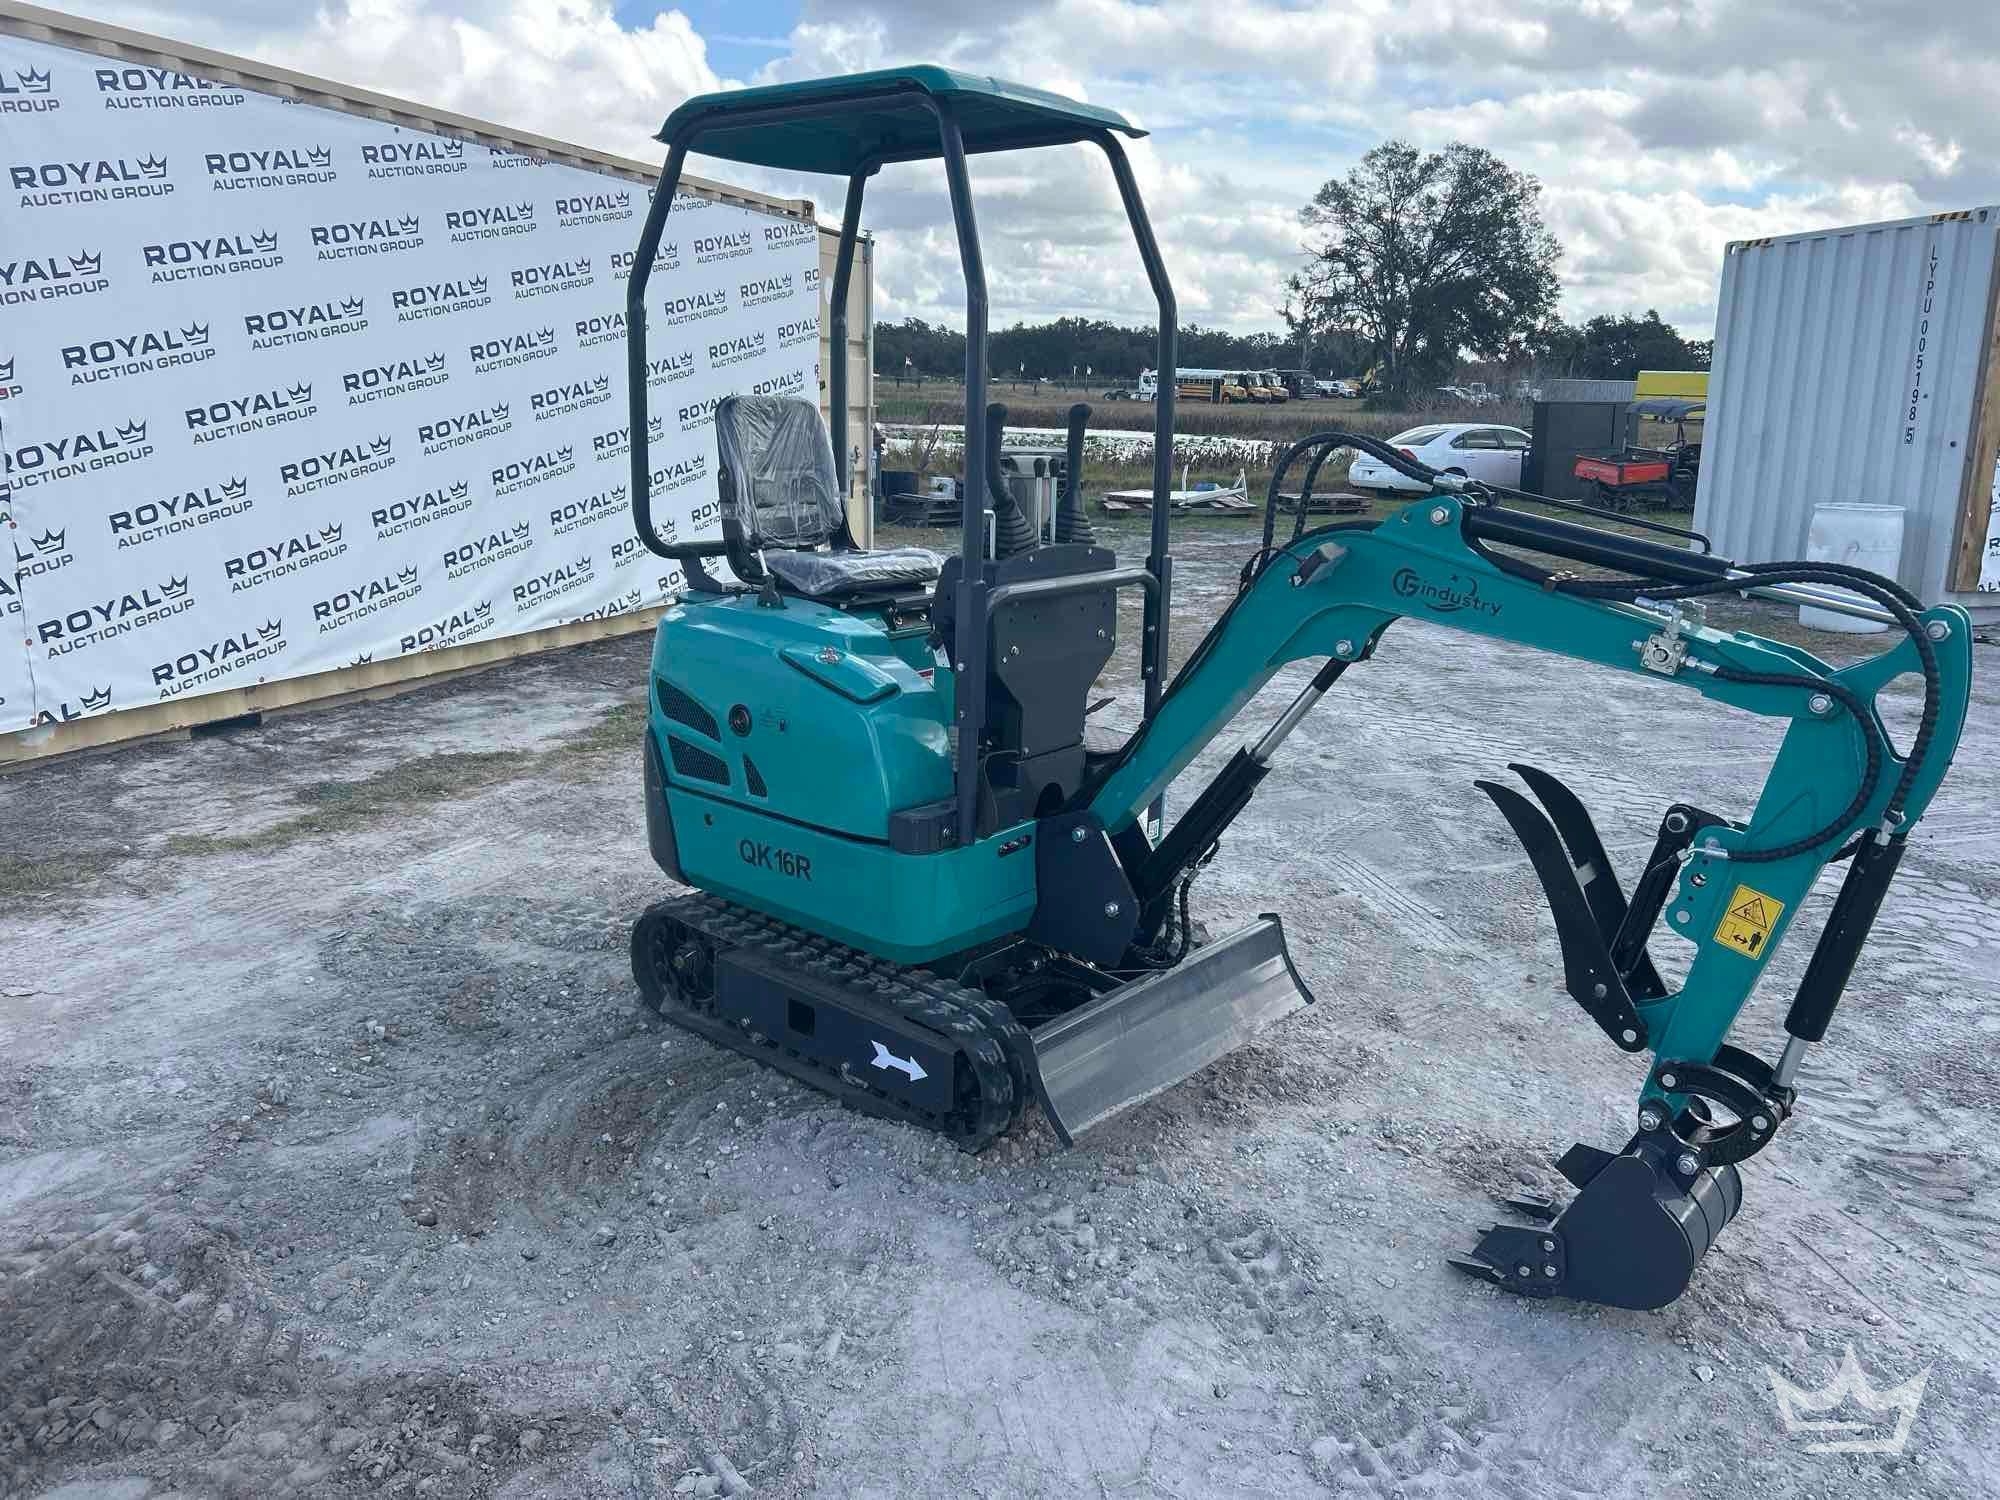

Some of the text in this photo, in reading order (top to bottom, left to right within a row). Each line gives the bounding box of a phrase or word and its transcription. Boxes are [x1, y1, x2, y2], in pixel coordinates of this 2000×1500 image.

[1, 99, 59, 112] ROUP
[105, 95, 245, 108] AUCTION GROUP
[204, 149, 308, 174] ROYAL
[361, 142, 444, 163] ROYAL
[9, 159, 139, 189] ROYAL
[214, 171, 336, 190] AUCTION GROUP
[368, 162, 467, 177] AUCTION GROUP
[21, 183, 174, 207] AUCTION GROUP
[555, 194, 616, 215] ROYAL
[686, 199, 712, 210] GROUP
[446, 205, 517, 229] ROYAL
[560, 210, 632, 227] AUCTION GROUP
[311, 219, 399, 245] ROYAL
[451, 223, 536, 242] AUCTION GROUP
[693, 233, 740, 253] ROYAL
[764, 222, 805, 241] ROYAL
[142, 236, 253, 266] ROYAL
[318, 238, 423, 260] AUCTION GROUP
[697, 247, 752, 264] AUCTION GROUP
[0, 257, 71, 284] YAL
[152, 256, 282, 282] AUCTION GROUP
[510, 262, 576, 286] ROYAL
[652, 260, 680, 272] GROUP
[40, 279, 108, 298] GROUP
[392, 280, 470, 308] ROYAL
[514, 277, 593, 299] AUCTION GROUP
[739, 277, 782, 298] ROYAL
[743, 289, 793, 307] AUCTION GROUP
[398, 296, 491, 322] AUCTION GROUP
[664, 293, 714, 315] ROYAL
[668, 305, 728, 326] AUCTION GROUP
[244, 303, 342, 335] ROYAL
[575, 312, 624, 336] ROYA
[777, 318, 816, 339] ROYAL
[252, 320, 368, 349] AUCTION GROUP
[470, 333, 538, 361] ROYAL
[579, 331, 618, 347] AUCTION
[708, 336, 754, 359] ROYAL
[61, 330, 183, 368] ROYAL
[475, 346, 556, 374] AUCTION GROUP
[711, 347, 766, 369] AUCTION GROUP
[72, 348, 215, 385] AUCTION GROUP
[342, 359, 426, 392] ROYAL
[667, 367, 694, 382] GROUP
[349, 373, 448, 405] AUCTION GROUP
[531, 380, 594, 410] ROYAL
[752, 374, 794, 397] ROYAL
[185, 391, 289, 429] ROYAL
[535, 392, 611, 421] AUCTION GROUP
[194, 405, 316, 444] AUCTION GROUP
[418, 409, 492, 443] ROYAL
[424, 421, 512, 455] AUCTION GROUP
[593, 426, 628, 451] ROY
[10, 445, 153, 490] UCTION GROUP
[280, 444, 371, 483] ROYAL
[287, 457, 395, 497] AUCTION GROUP
[491, 452, 557, 485] ROYAL
[495, 462, 575, 497] AUCTION GROUP
[650, 469, 706, 498] UCTION GROUP
[108, 487, 222, 533] ROYAL
[371, 489, 450, 527] ROYAL
[377, 499, 471, 540] AUCTION GROUP
[549, 492, 611, 525] ROYAL
[554, 501, 628, 536] AUCTION GROUP
[691, 498, 720, 523] ROY
[118, 500, 252, 548] AUCTION GROUP
[224, 533, 321, 579] ROYAL
[442, 530, 513, 568] ROYAL
[448, 539, 532, 580] AUCTION GROUP
[17, 554, 72, 579] ROUP
[232, 543, 346, 592] AUCTION GROUP
[657, 565, 688, 591] ROY
[512, 564, 576, 601] ROYAL
[517, 572, 594, 612] AUCTION GROUP
[312, 576, 398, 621] ROYAL
[319, 584, 421, 633] AUCTION GROUP
[37, 589, 161, 643] ROYAL
[48, 598, 194, 658] AUCTION GROUP
[457, 617, 495, 640] GROUP
[399, 610, 475, 653] ROYAL
[152, 632, 258, 685] ROYAL
[160, 640, 287, 698] AUCTION GROUP
